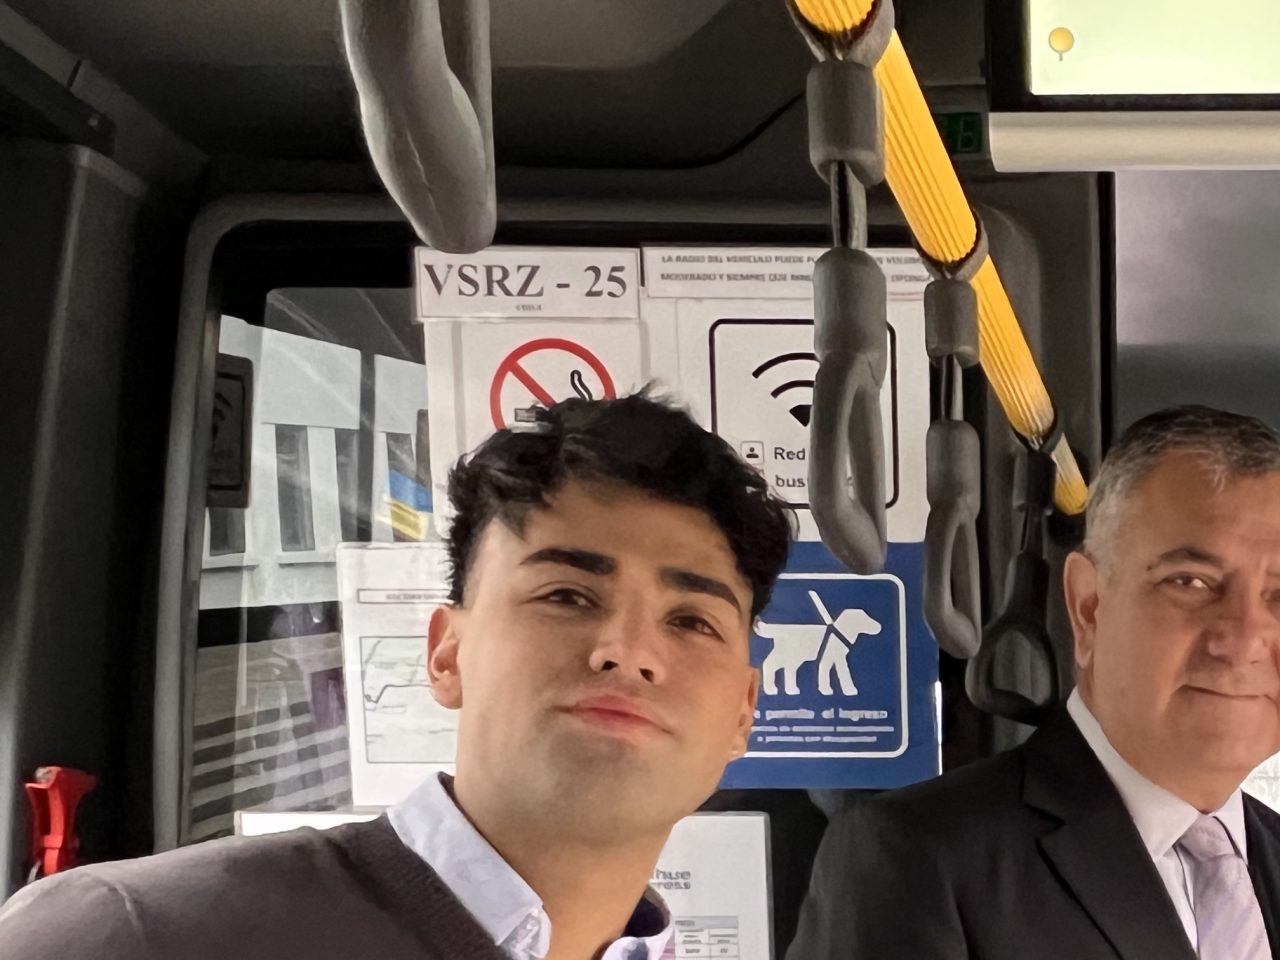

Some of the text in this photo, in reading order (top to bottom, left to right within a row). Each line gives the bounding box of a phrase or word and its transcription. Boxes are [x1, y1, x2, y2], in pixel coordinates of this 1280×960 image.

[423, 263, 545, 297] VSRZ
[583, 265, 628, 298] 25
[773, 447, 806, 460] Red
[775, 475, 806, 487] bus
